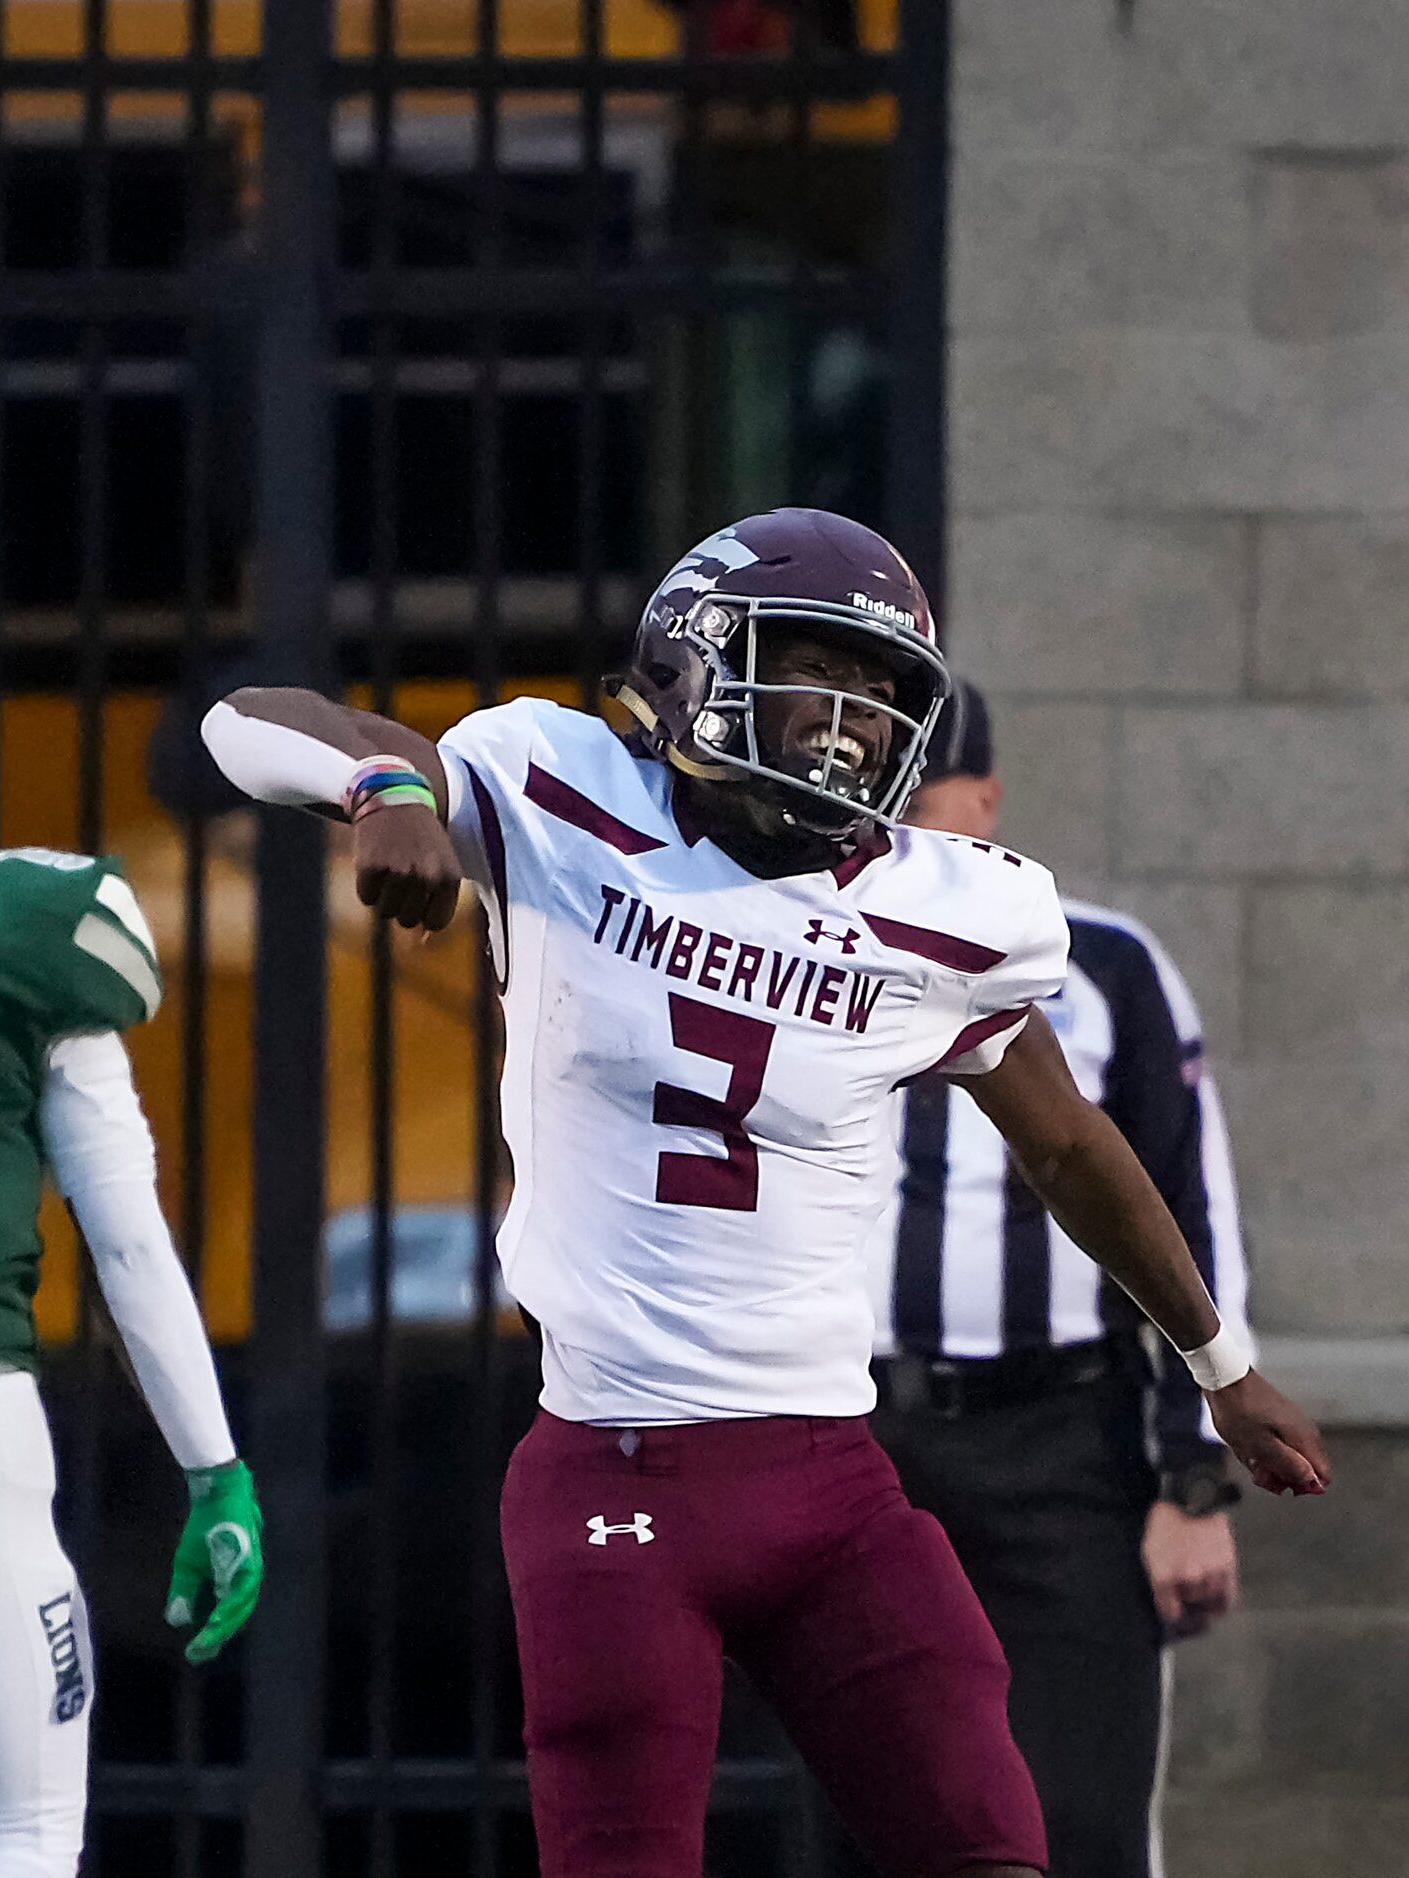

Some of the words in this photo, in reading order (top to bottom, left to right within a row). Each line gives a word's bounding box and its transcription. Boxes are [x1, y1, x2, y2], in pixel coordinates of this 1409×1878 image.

[852, 592, 916, 630] Riddell
[593, 884, 887, 1034] TIMBERVIEW
[651, 991, 777, 1212] 3
[39, 1591, 85, 1724] LIONS
